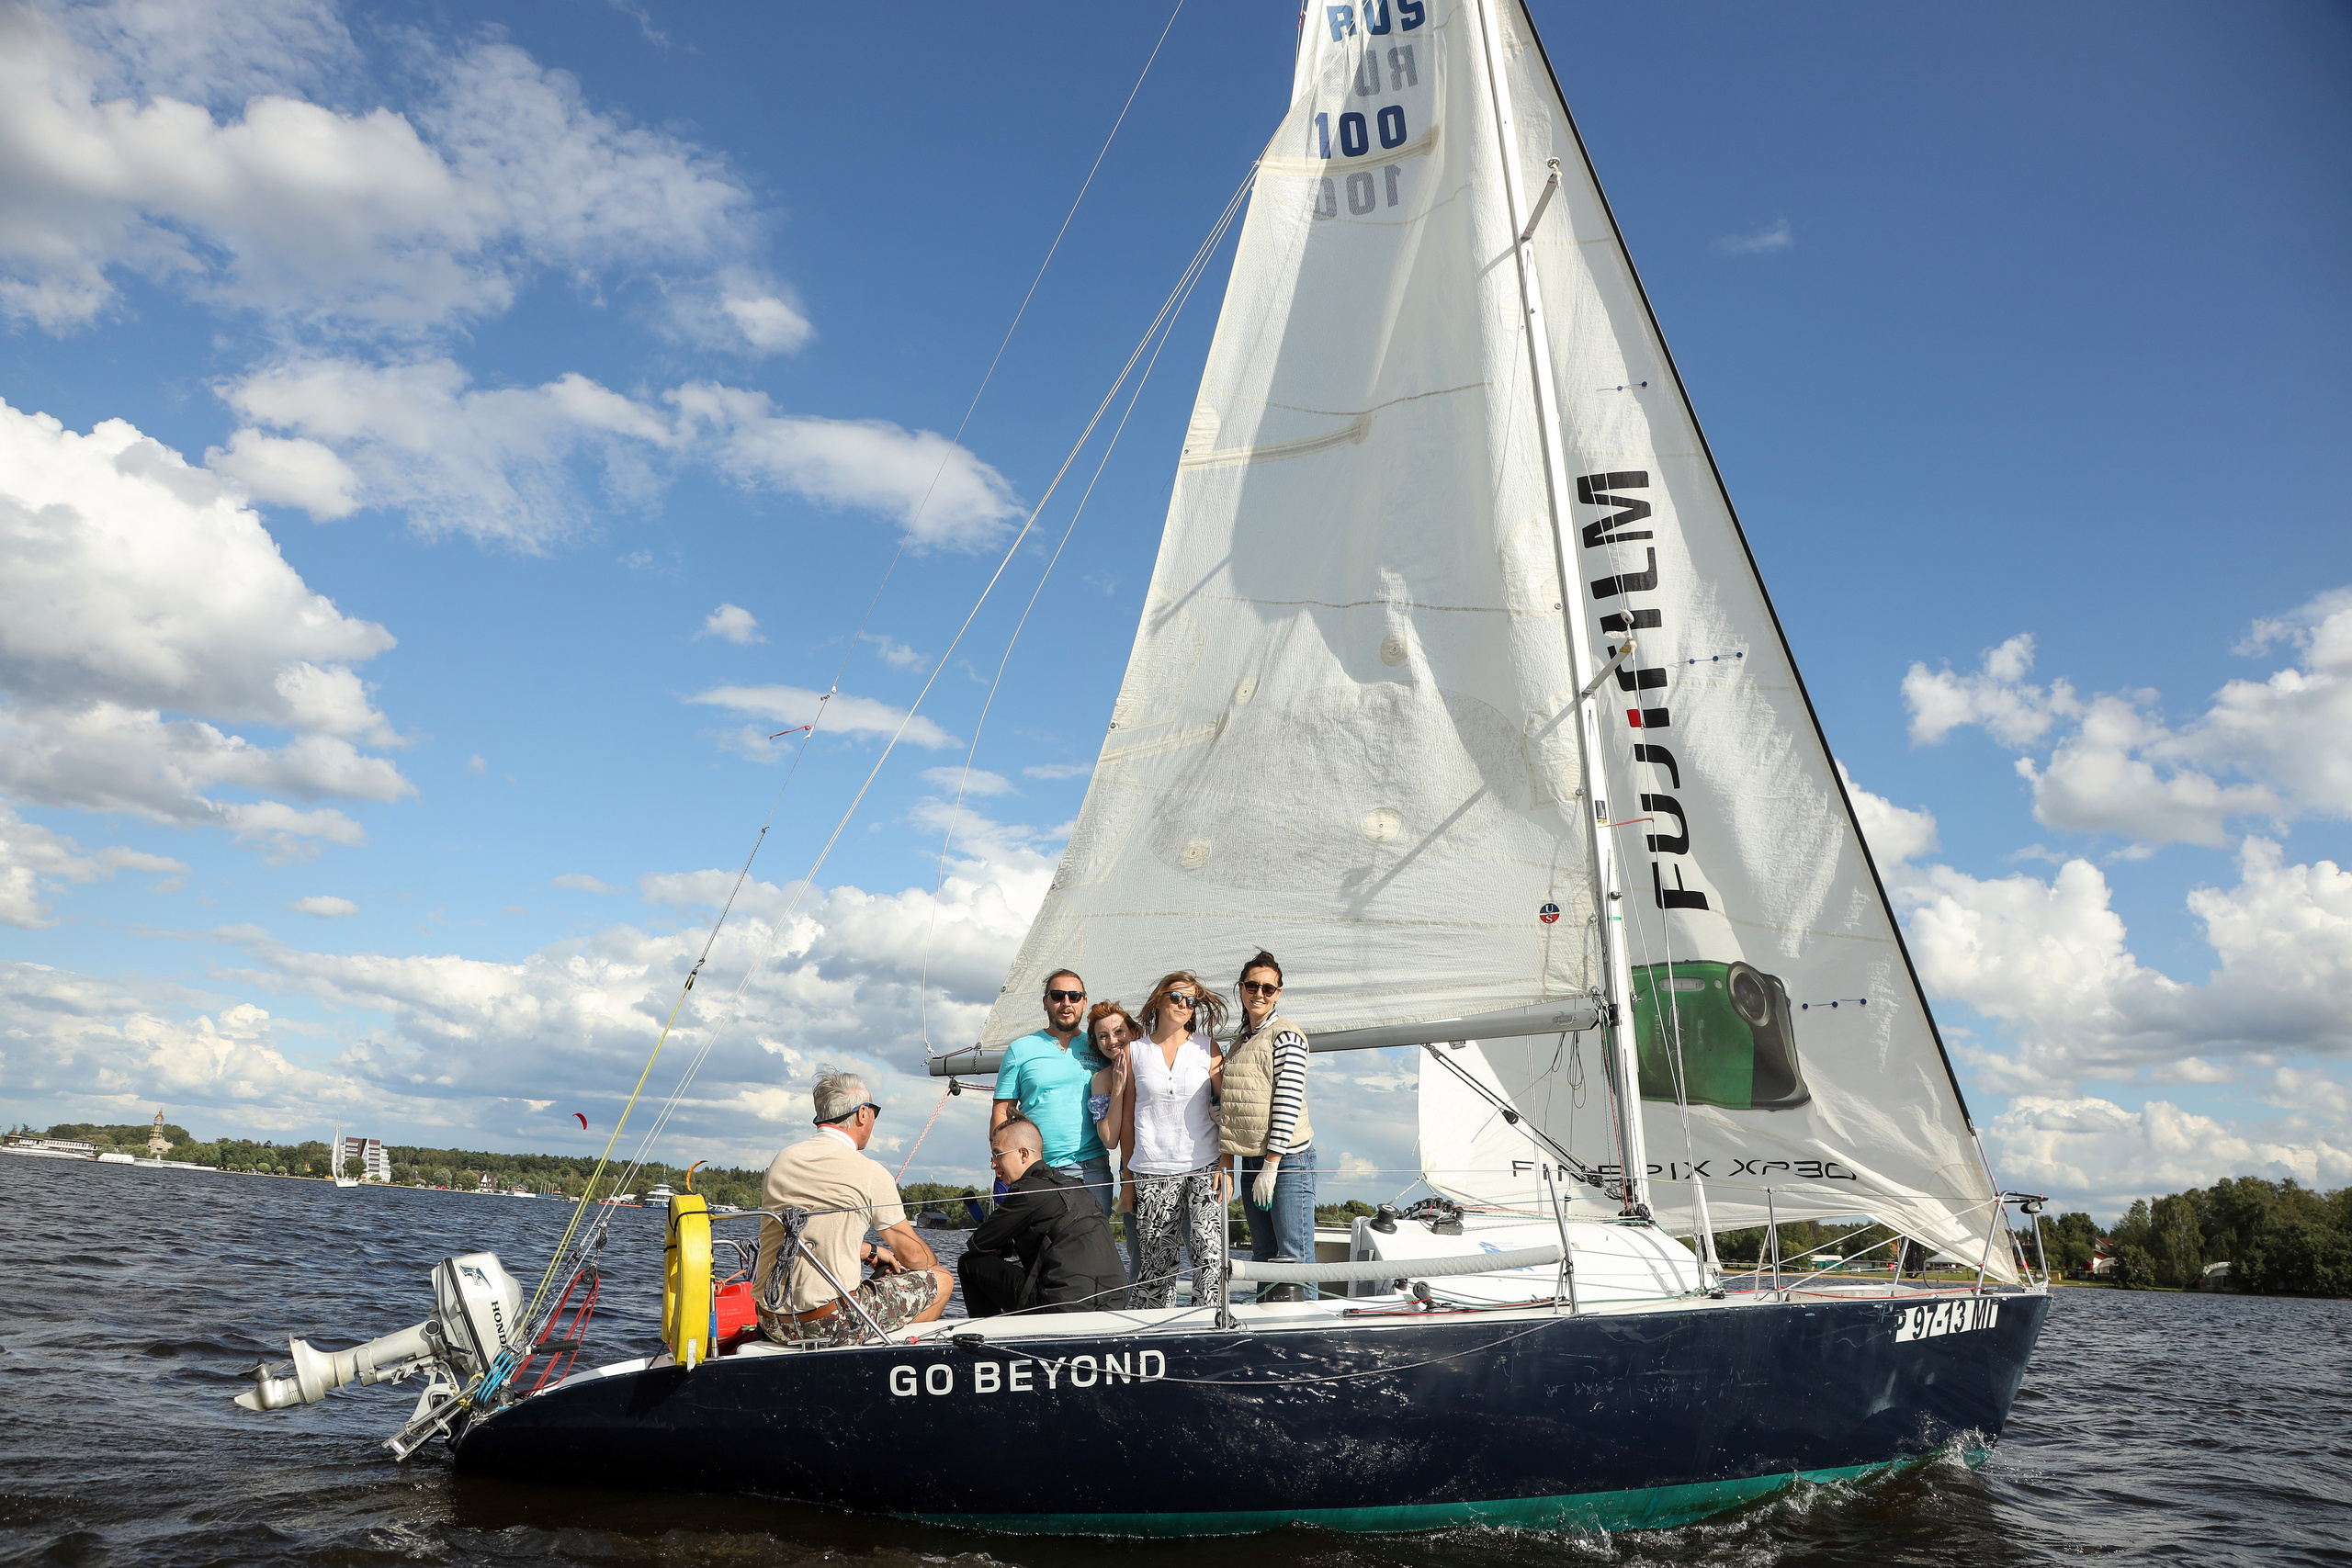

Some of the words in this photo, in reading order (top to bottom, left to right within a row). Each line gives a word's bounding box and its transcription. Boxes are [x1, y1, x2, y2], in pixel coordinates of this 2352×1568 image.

[1326, 0, 1426, 42] RUS
[1314, 105, 1408, 159] 100
[1577, 470, 1710, 910] FUJIFILM
[1727, 1158, 1857, 1180] XP30
[491, 1300, 507, 1348] HOND
[889, 1364, 954, 1397] GO
[974, 1349, 1166, 1393] BEYOND
